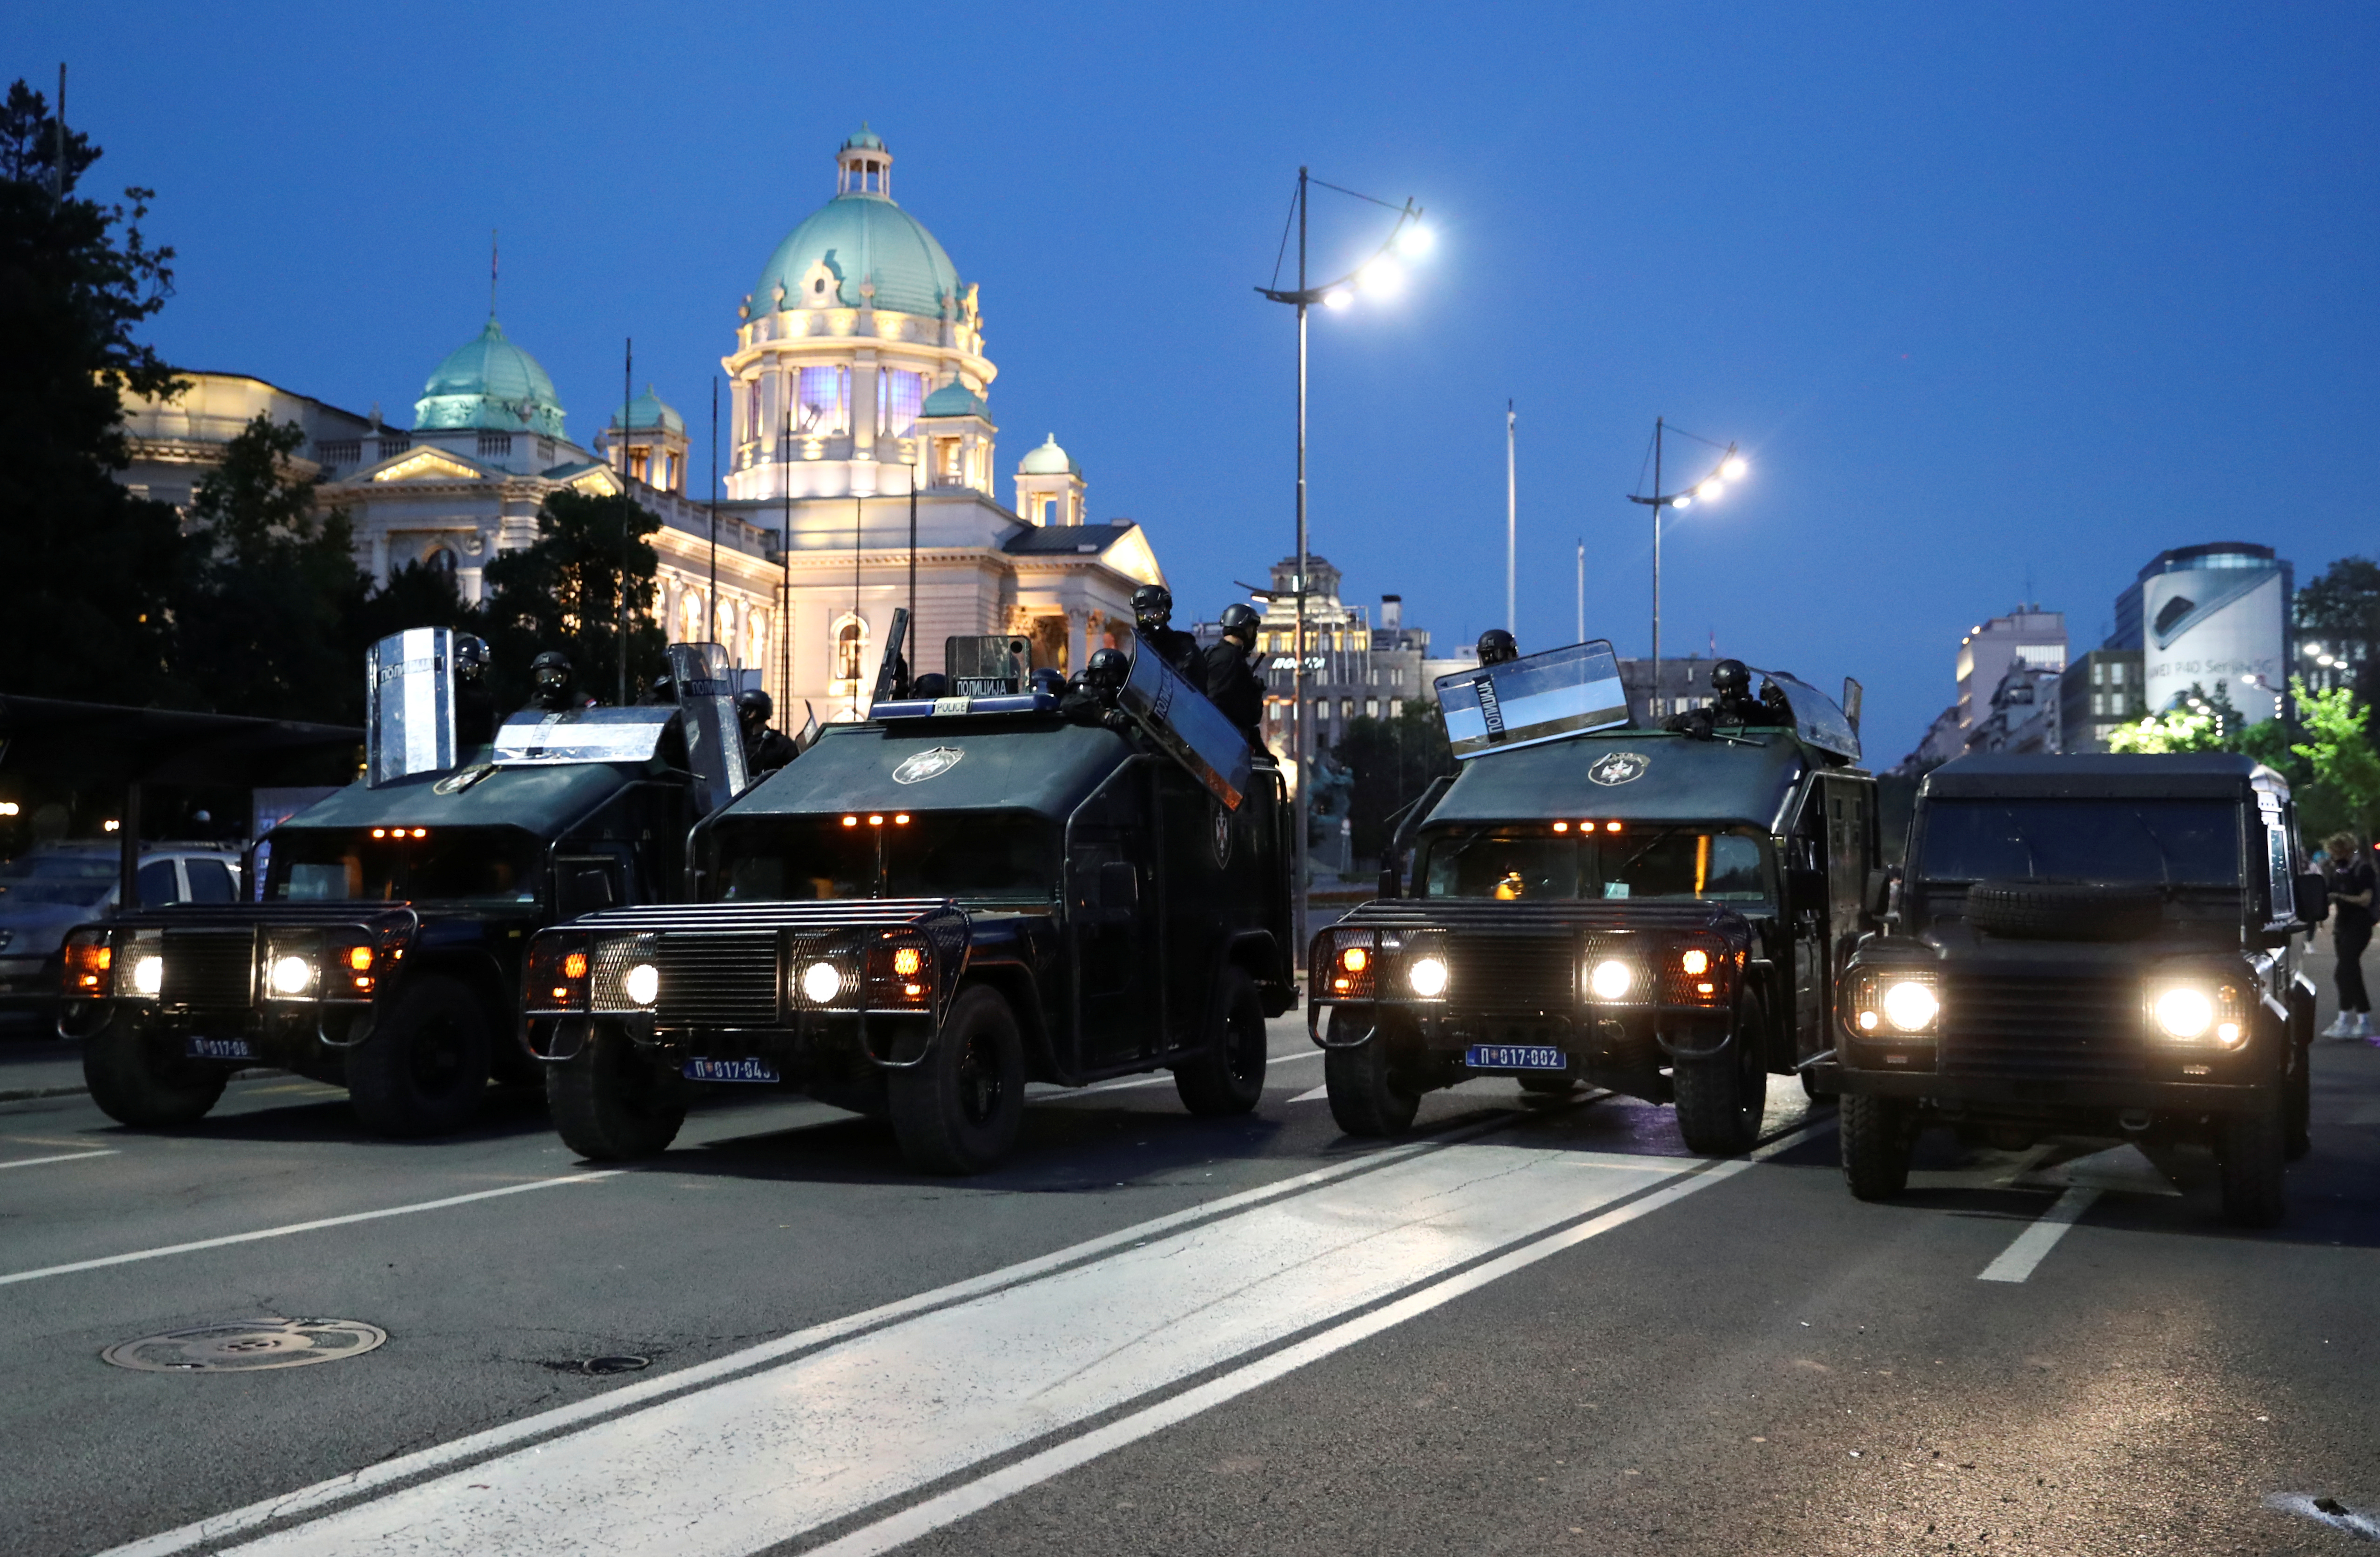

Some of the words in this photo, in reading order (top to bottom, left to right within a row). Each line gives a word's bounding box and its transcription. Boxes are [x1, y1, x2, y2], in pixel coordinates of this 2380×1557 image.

[957, 680, 1007, 696] ПОЛИЦИЈА
[937, 702, 966, 712] POLICE
[1477, 680, 1504, 733] ПОЛИЦИЈА
